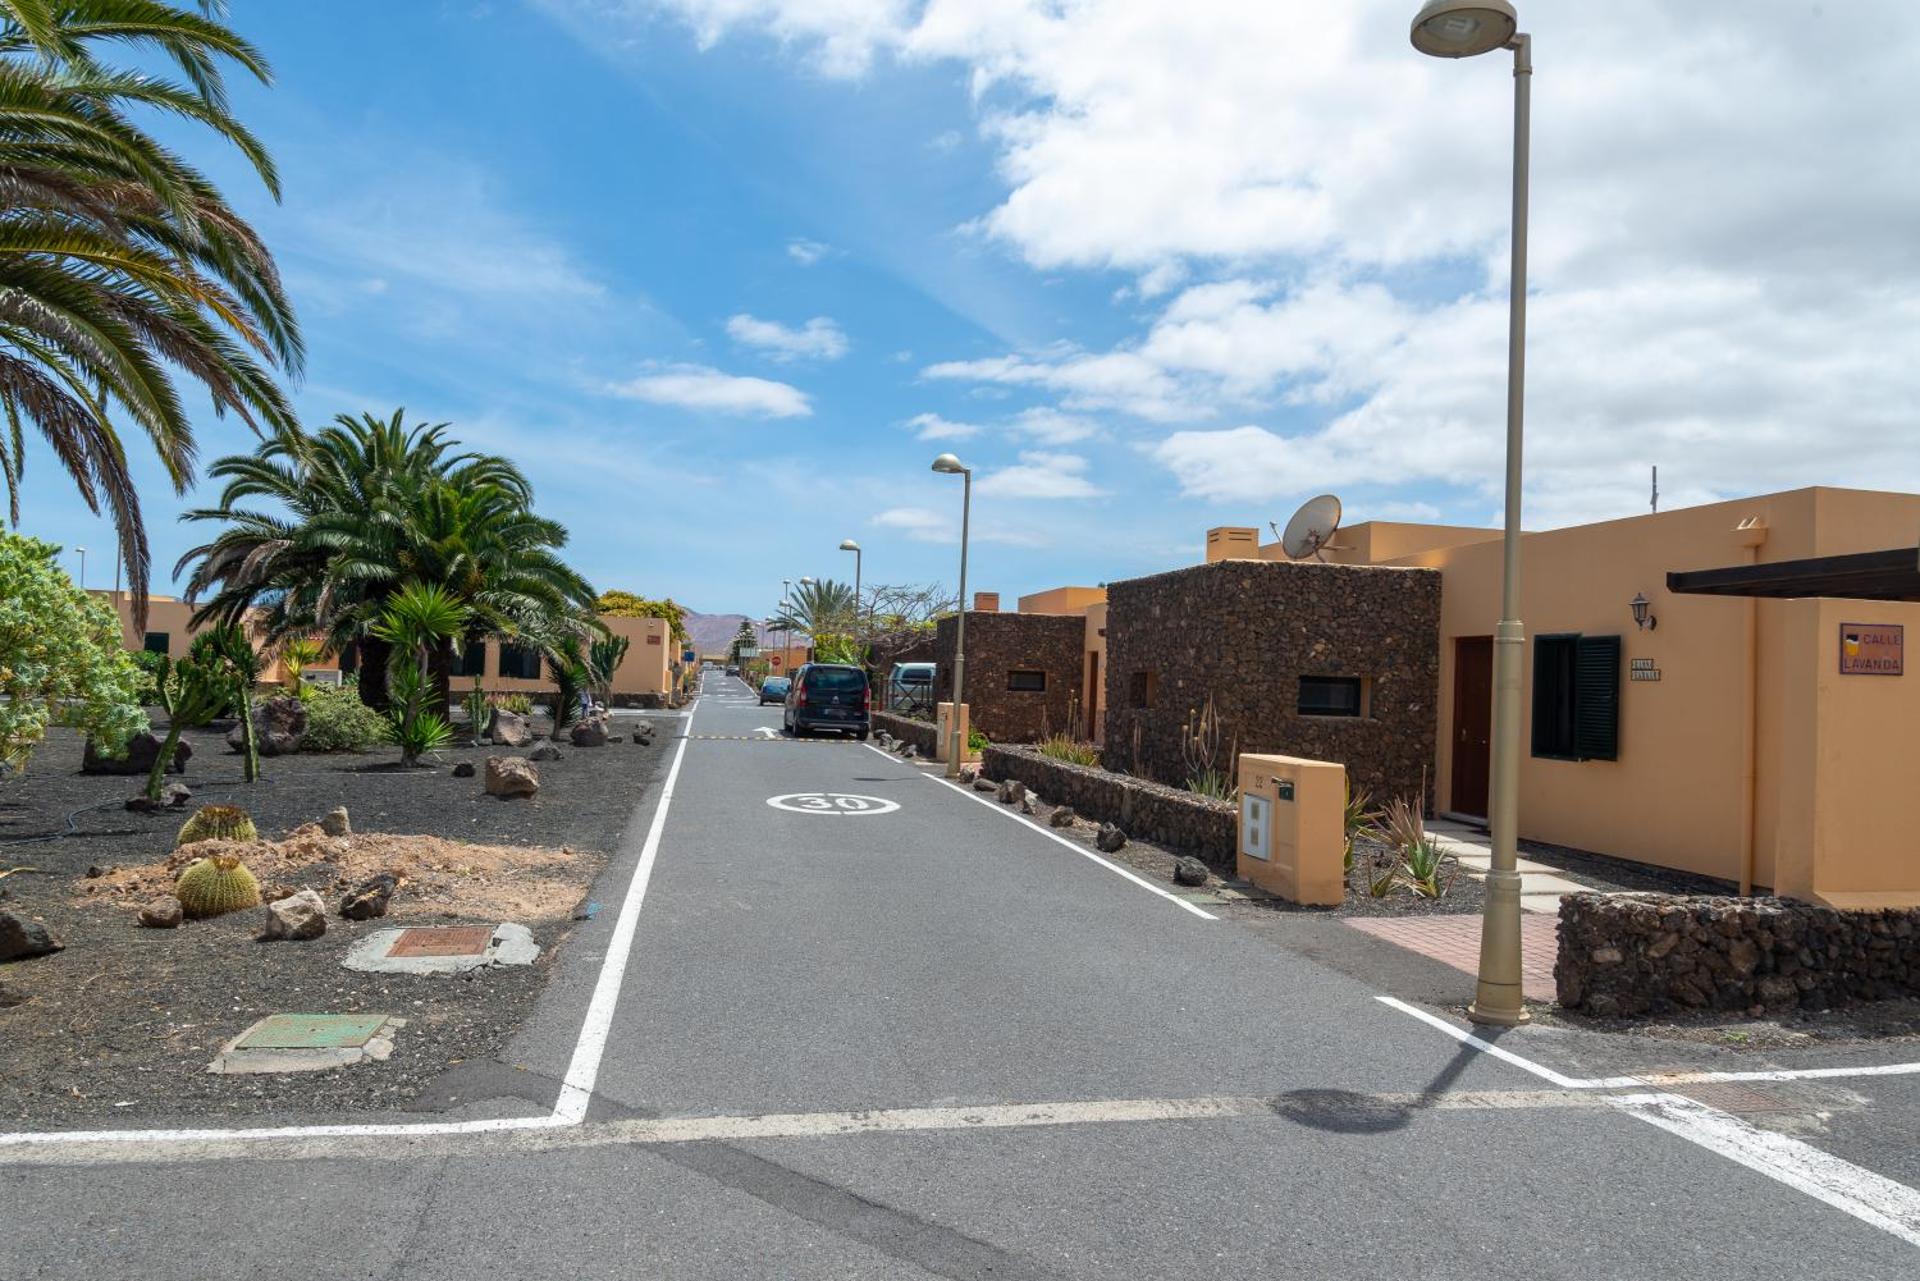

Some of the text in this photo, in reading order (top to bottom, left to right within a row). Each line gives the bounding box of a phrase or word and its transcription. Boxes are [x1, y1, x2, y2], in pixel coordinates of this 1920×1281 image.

[1863, 633, 1901, 646] CALLE
[1844, 658, 1900, 670] LAVANDA
[798, 797, 869, 810] 30
